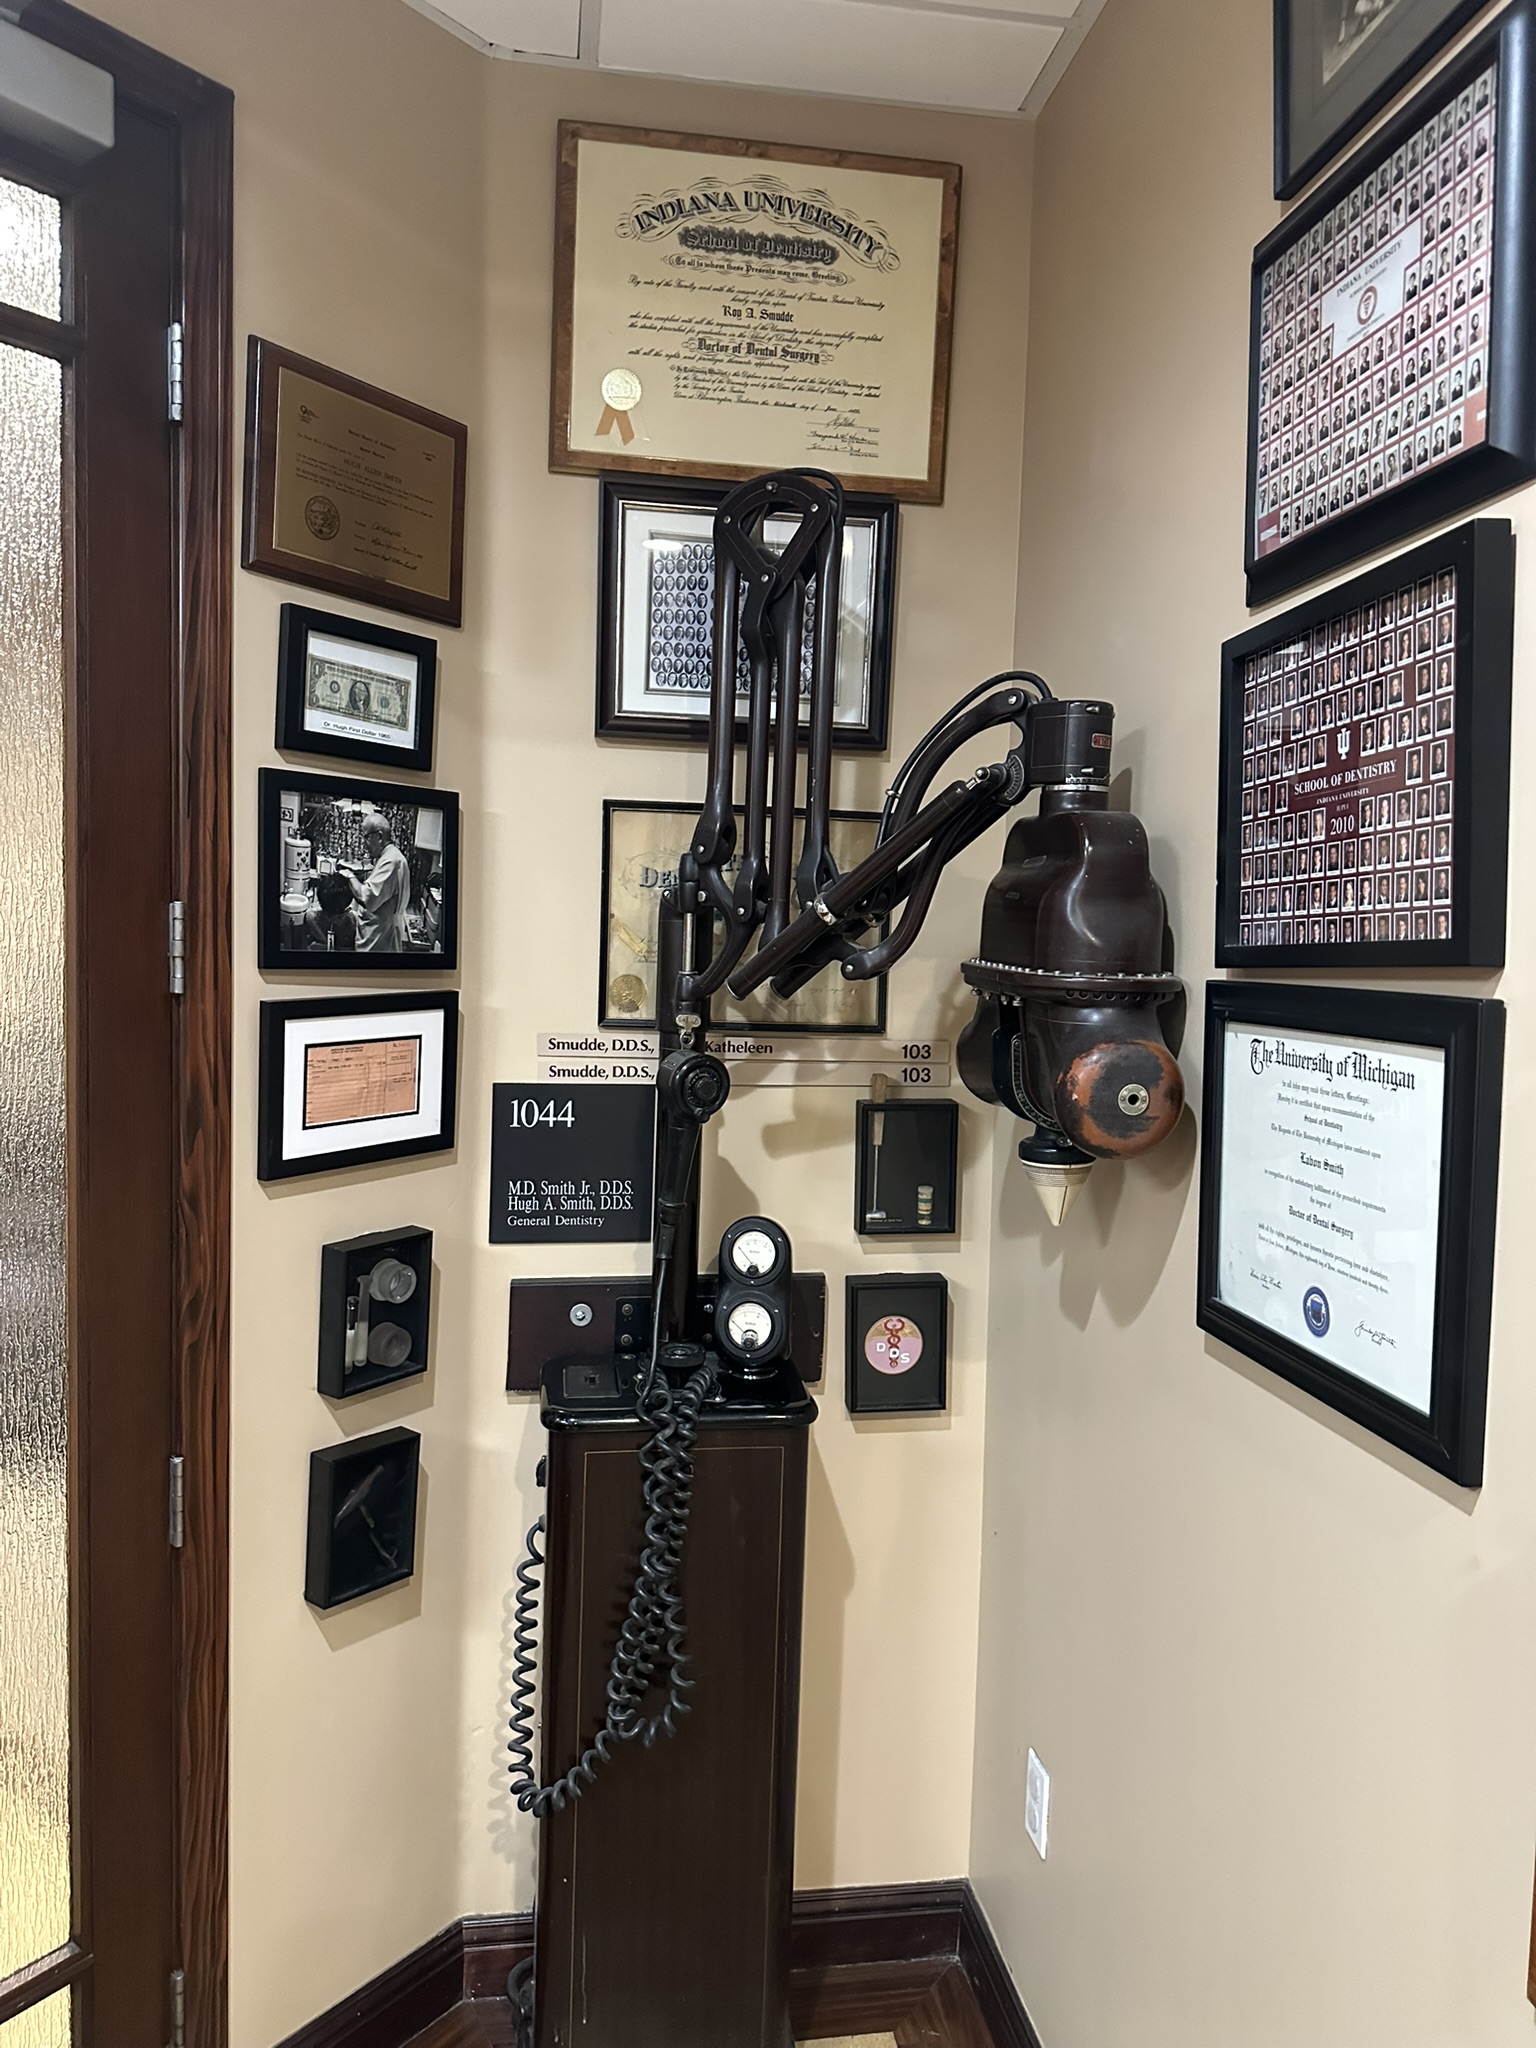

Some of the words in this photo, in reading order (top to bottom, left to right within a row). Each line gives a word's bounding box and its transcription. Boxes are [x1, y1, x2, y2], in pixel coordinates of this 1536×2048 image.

[634, 191, 741, 234] INDIANA
[744, 191, 883, 260] UNIVERSITY
[687, 231, 738, 251] School
[742, 236, 759, 252] of
[762, 240, 831, 263] Dentistry
[745, 263, 776, 275] Presents
[722, 305, 742, 320] Roy
[745, 307, 758, 319] A.
[760, 308, 794, 322] Smudde
[697, 337, 730, 353] Doctor
[731, 342, 743, 354] of
[745, 342, 777, 358] Dental
[780, 344, 820, 364] Surgery
[333, 723, 348, 731] Hugh
[361, 728, 377, 736] Dollar
[1294, 777, 1328, 795] SCHOOL
[1331, 773, 1343, 786] OF
[1345, 759, 1397, 783] DENTISTRY
[1316, 794, 1338, 804] INDIANA
[1339, 787, 1369, 800] UNIVERSITY
[1330, 815, 1355, 835] 2010
[548, 1038, 608, 1053] Smudde,
[612, 1039, 655, 1053] D.D.S.,
[705, 1041, 773, 1054] Katheleen
[901, 1044, 932, 1060] 103
[549, 1065, 609, 1080] Smudde,
[612, 1066, 655, 1080] D.D.S.,
[900, 1067, 932, 1083] 103
[1250, 1038, 1273, 1075] The
[1276, 1040, 1333, 1082] University
[1336, 1055, 1351, 1077] of
[1352, 1051, 1416, 1091] Michigan
[510, 1099, 575, 1128] 1044
[1323, 1158, 1344, 1179] Smith
[508, 1181, 536, 1195] M.D.
[540, 1180, 576, 1195] Smith
[580, 1180, 595, 1196] Jr.,
[600, 1180, 634, 1195] D.D.S.
[508, 1196, 539, 1214] Hugh
[544, 1196, 556, 1210] A.
[560, 1196, 596, 1211] Smith,
[600, 1195, 633, 1210] D.D.S.
[507, 1215, 550, 1226] General
[555, 1215, 605, 1228] Dentistry
[1289, 1205, 1305, 1220] Doctor
[1306, 1213, 1312, 1222] of
[1313, 1214, 1329, 1229] Dental
[1331, 1221, 1354, 1240] Surgery
